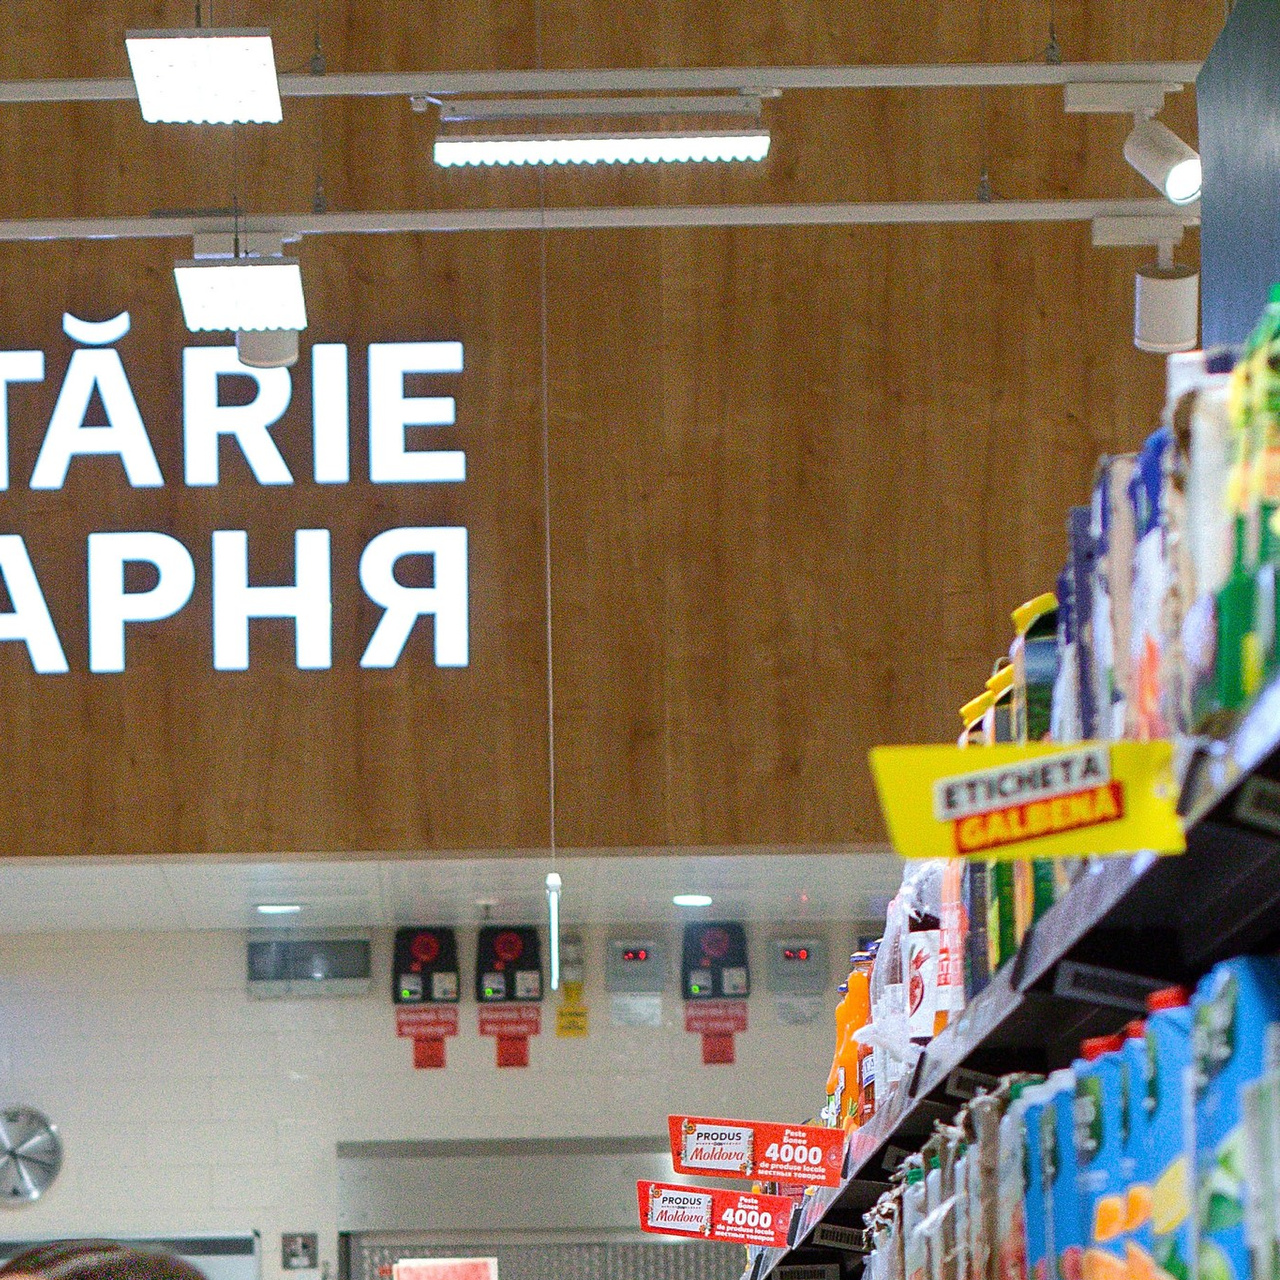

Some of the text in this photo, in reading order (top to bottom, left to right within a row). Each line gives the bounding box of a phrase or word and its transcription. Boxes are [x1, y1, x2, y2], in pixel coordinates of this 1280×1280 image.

[943, 754, 1102, 810] ETICHETA
[696, 1131, 742, 1142] PRODUS
[785, 1129, 806, 1139] Peste
[690, 1146, 744, 1162] Moldova
[765, 1143, 822, 1165] 4000
[770, 1162, 801, 1172] produse
[803, 1165, 826, 1173] locale
[662, 1196, 702, 1206] PRODUS
[739, 1196, 758, 1204] Peste
[655, 1209, 704, 1223] Moldova
[722, 1208, 772, 1228] 4000
[726, 1225, 753, 1234] produse
[755, 1228, 775, 1236] locale
